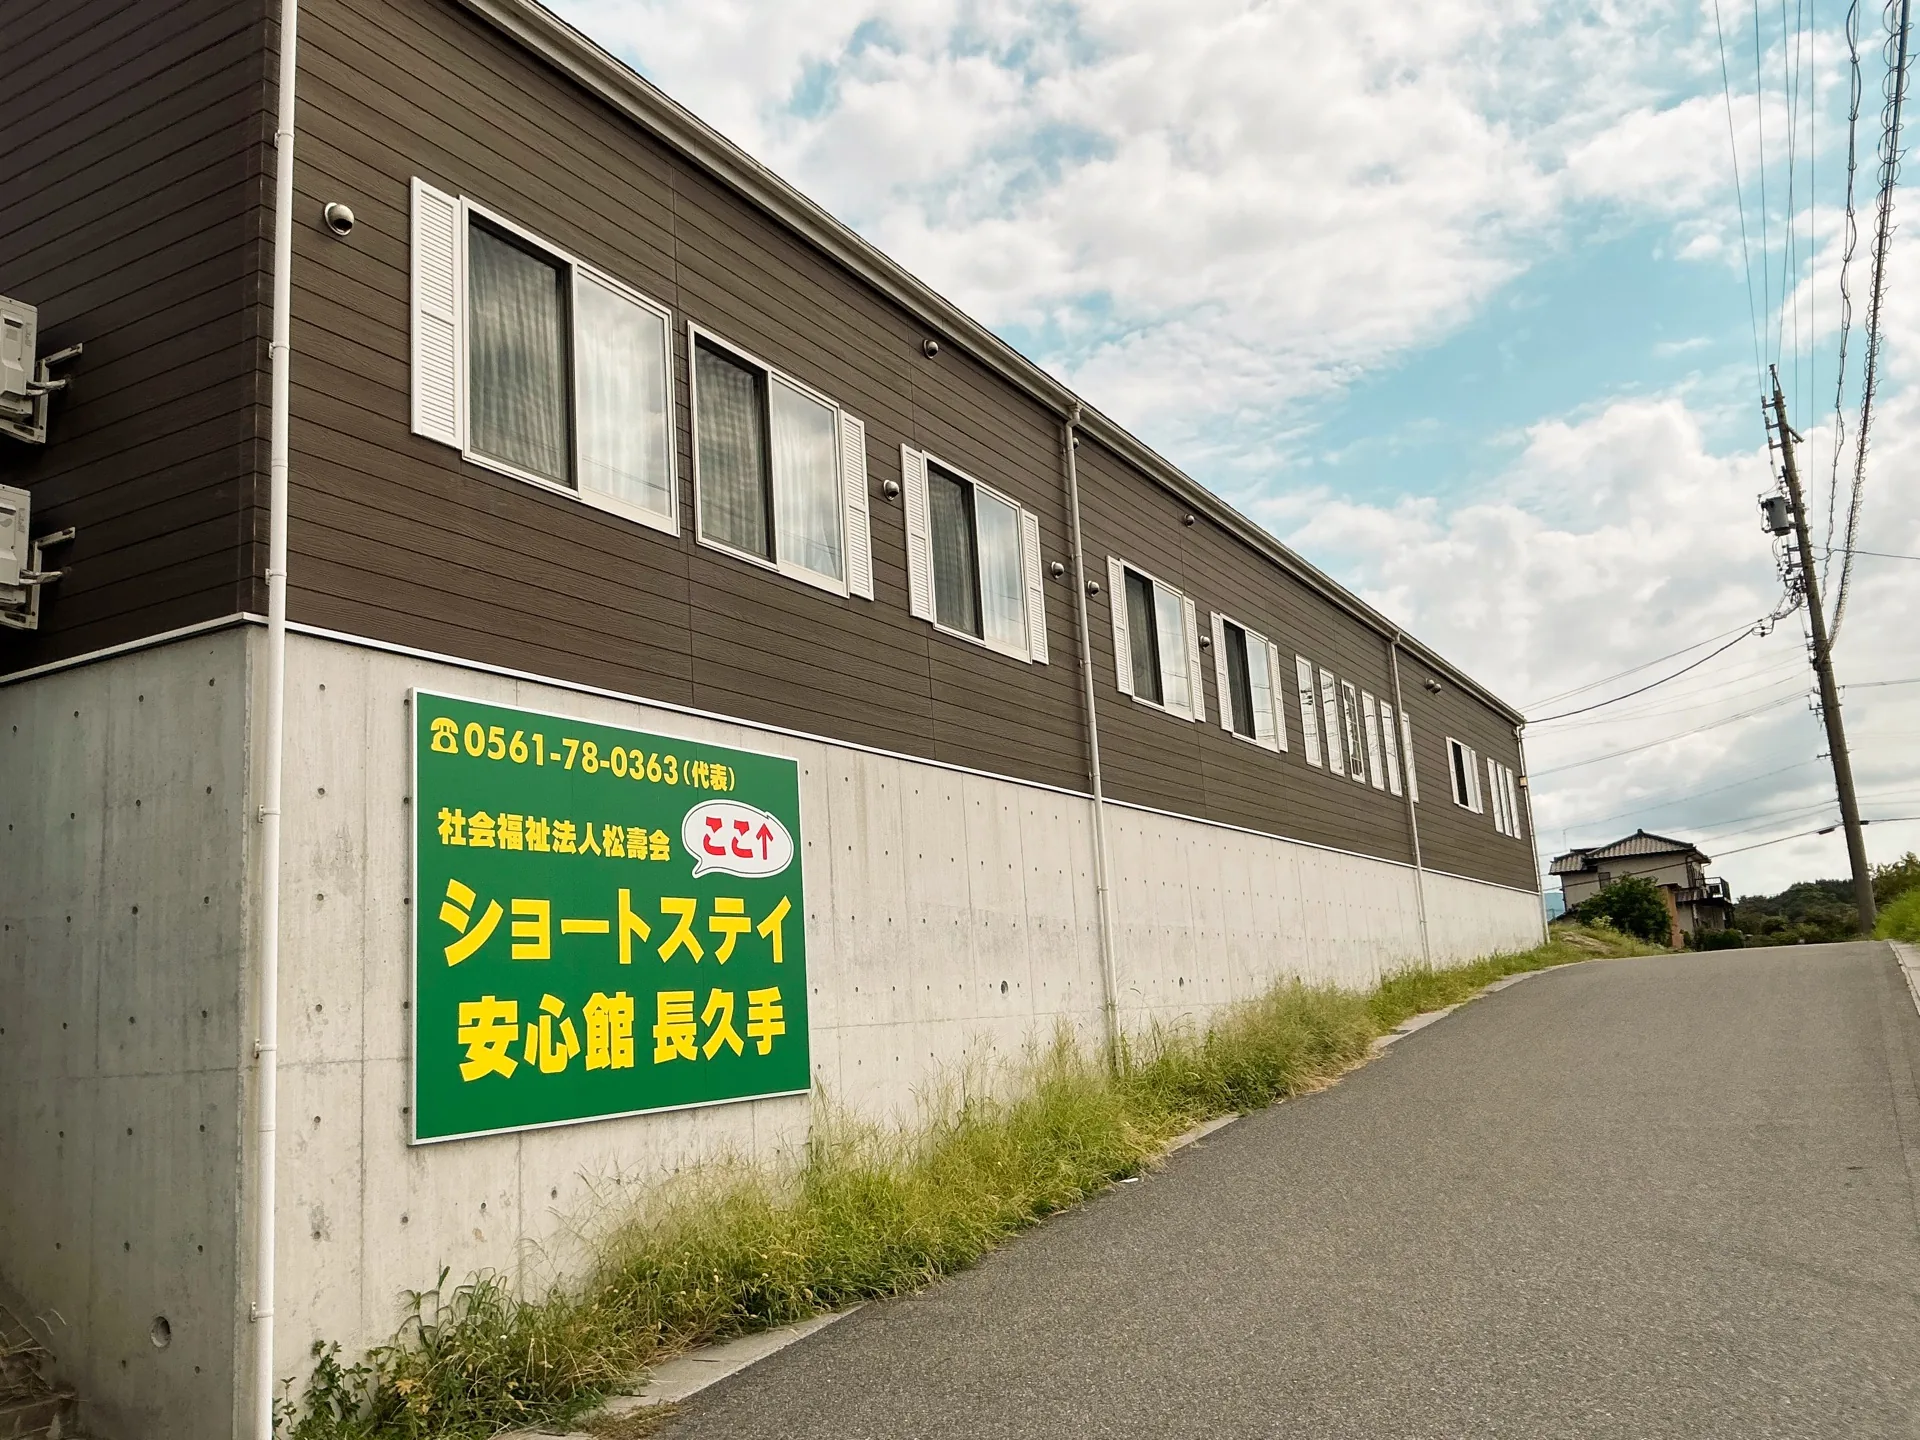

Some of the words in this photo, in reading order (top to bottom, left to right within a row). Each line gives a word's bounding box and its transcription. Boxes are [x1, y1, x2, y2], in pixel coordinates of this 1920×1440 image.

[438, 807, 670, 861] 社会福祉法人松壽会
[703, 816, 754, 858] ここ
[439, 878, 791, 967] ショートステイ
[457, 991, 635, 1082] 安心館
[653, 986, 786, 1064] 長久手
